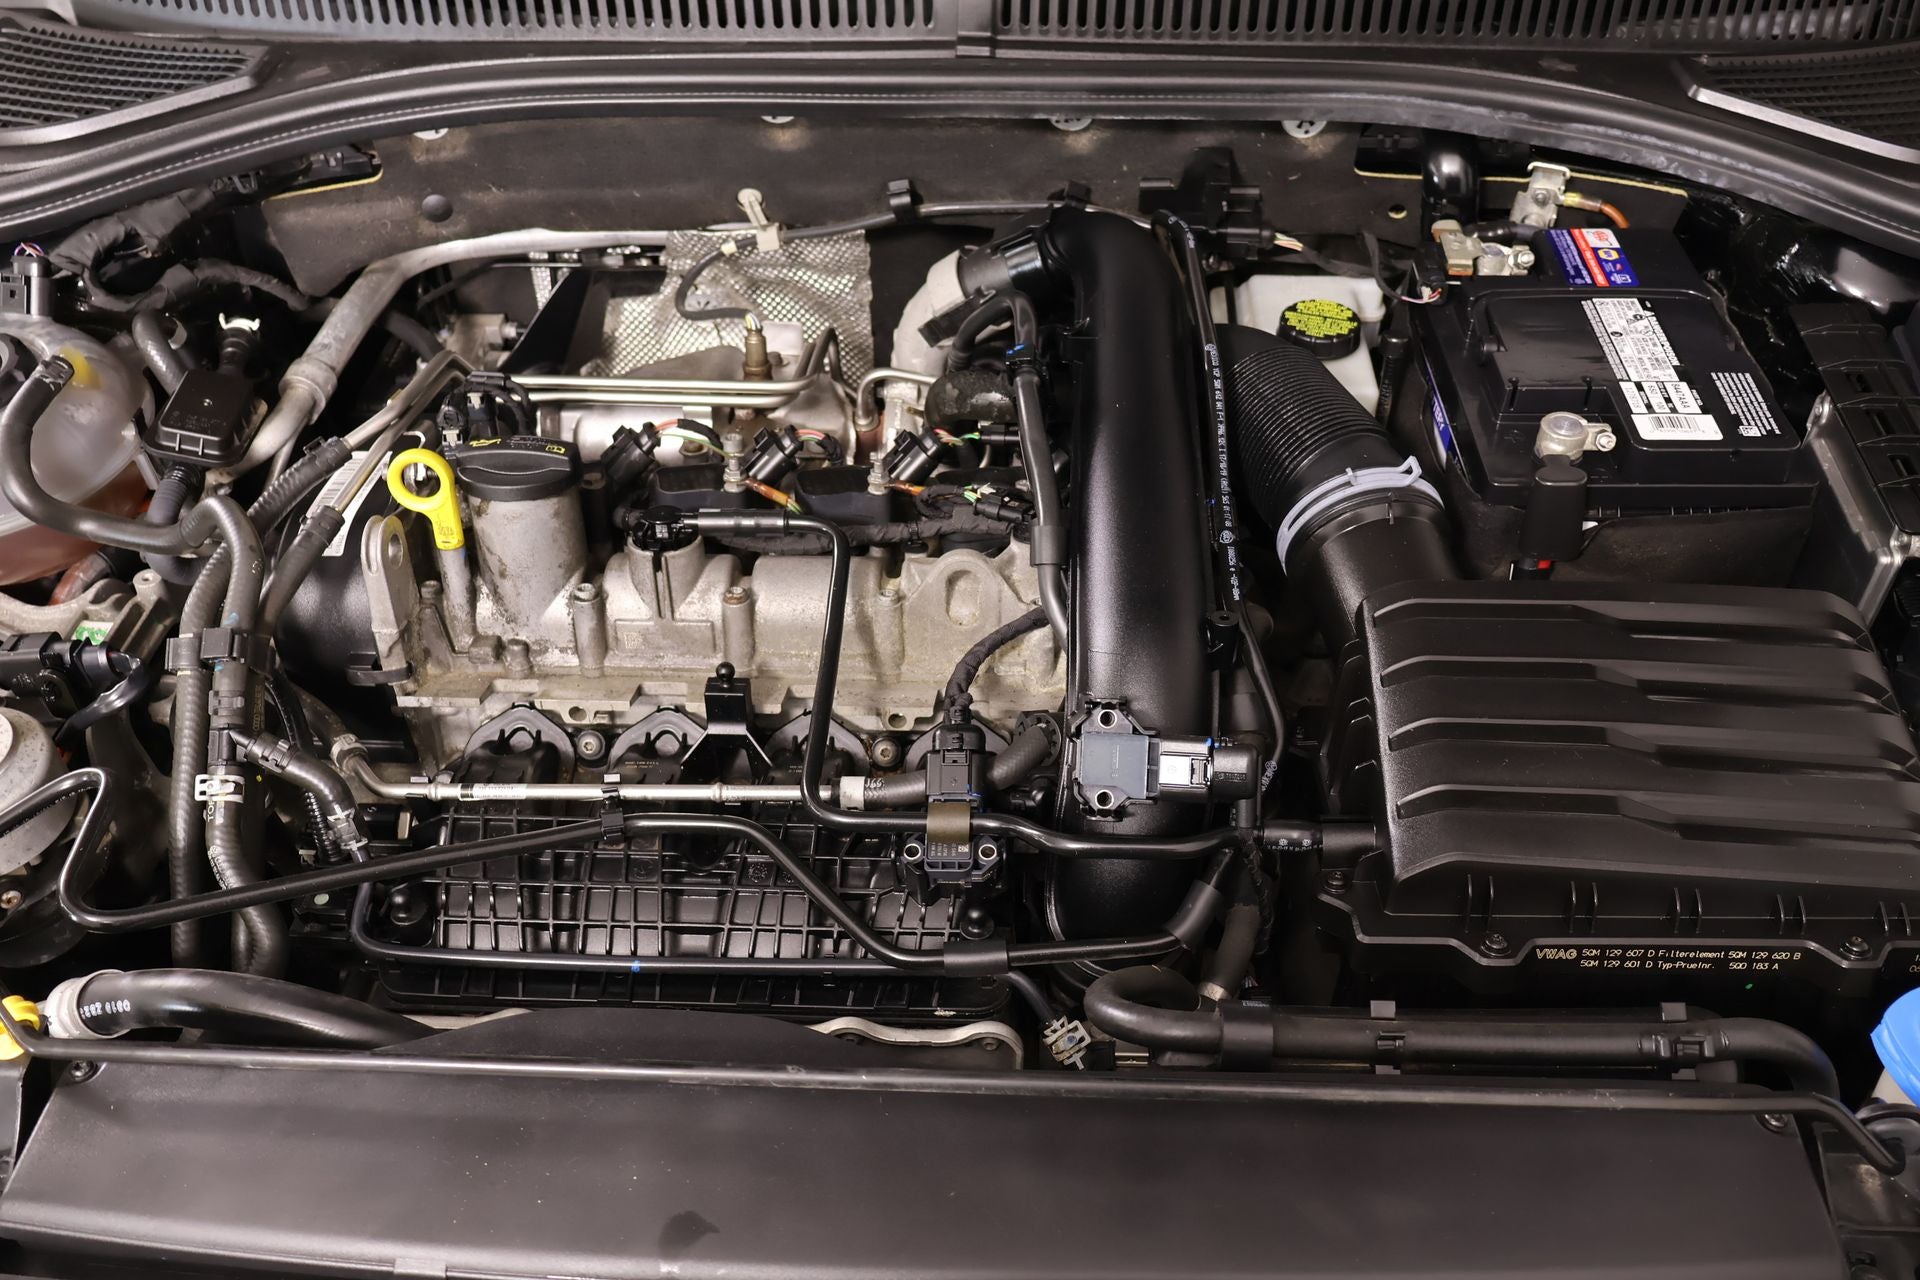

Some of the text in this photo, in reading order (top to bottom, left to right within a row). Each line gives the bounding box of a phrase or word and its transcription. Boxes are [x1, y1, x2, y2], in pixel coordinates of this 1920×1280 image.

[1536, 948, 1577, 959] VWAG
[1606, 949, 1622, 957] 129
[1626, 949, 1644, 957] 607
[1647, 949, 1656, 957] D
[1658, 949, 1724, 959] Filterelement
[1751, 951, 1768, 959] 129
[1771, 951, 1790, 960] 620
[1793, 952, 1802, 960] B
[1603, 960, 1620, 968] 129
[1624, 960, 1640, 968] 601
[1645, 960, 1654, 968] D
[1752, 962, 1768, 970] 183
[1771, 962, 1779, 970] A
